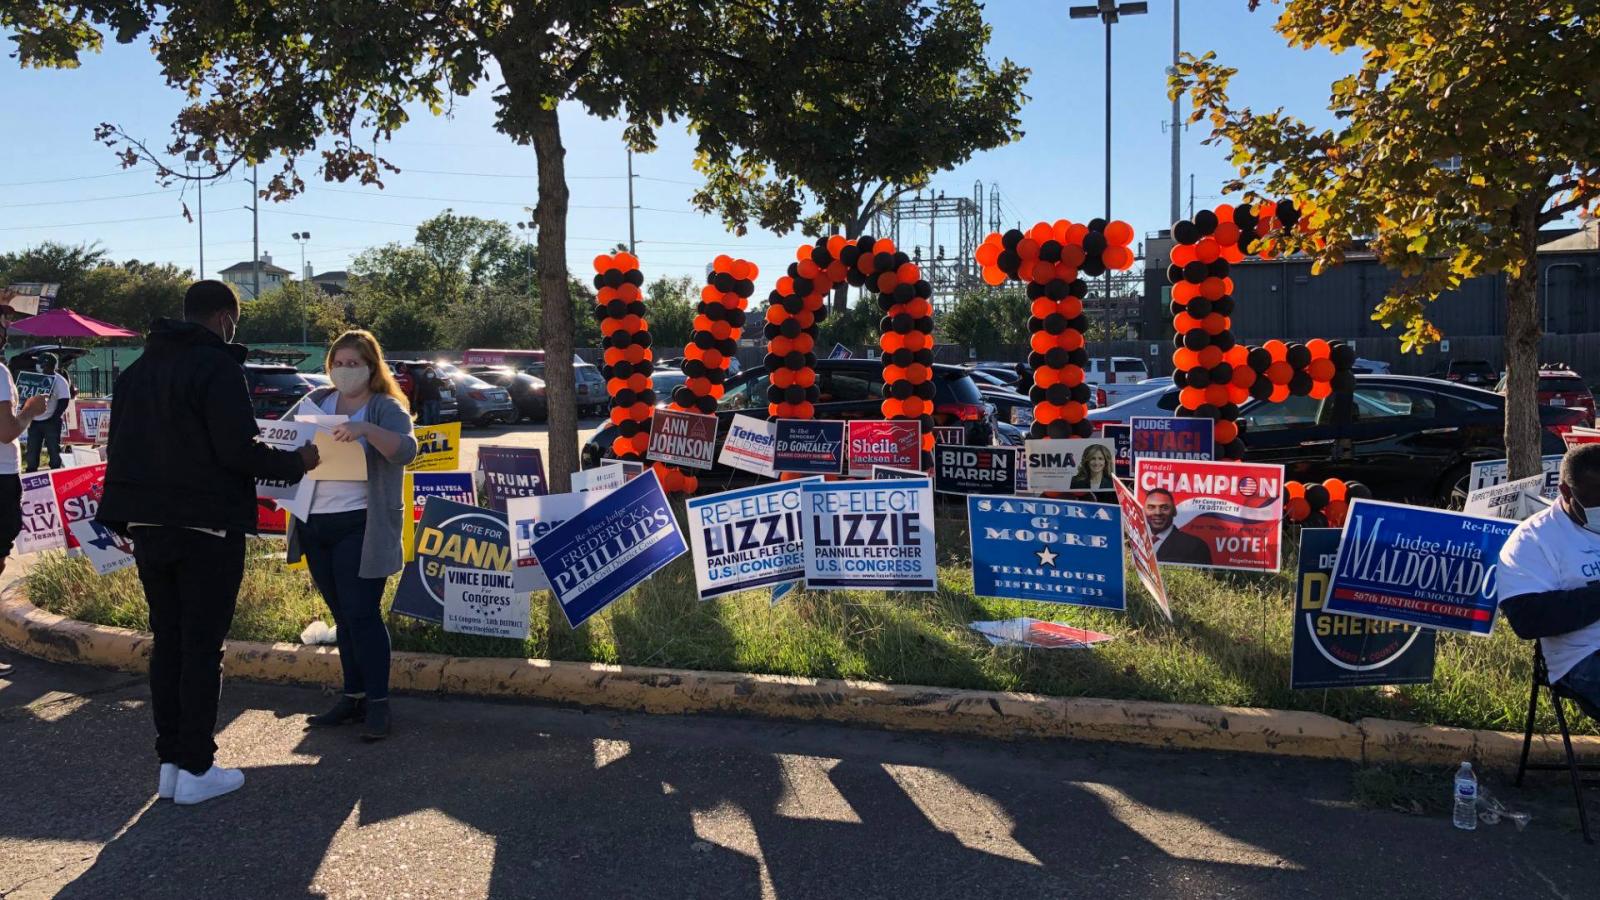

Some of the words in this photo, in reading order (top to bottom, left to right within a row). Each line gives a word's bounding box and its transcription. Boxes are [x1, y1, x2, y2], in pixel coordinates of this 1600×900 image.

[662, 416, 688, 436] ANN
[1134, 420, 1170, 430] JUDGE
[268, 428, 298, 441] 2020
[1134, 431, 1200, 450] STACI
[650, 433, 713, 460] JOHNSON
[776, 440, 788, 451] ED
[790, 440, 832, 452] GONZALEZ
[852, 438, 898, 454] Sheila
[854, 454, 890, 463] Jackson
[894, 455, 911, 463] Lee
[942, 451, 1008, 468] BIDEN
[1029, 453, 1076, 468] SIMA
[488, 472, 540, 488] TRUMP
[942, 466, 1008, 482] HARRIS
[497, 487, 535, 497] PENCE
[700, 490, 800, 526] RE-ELEC
[812, 490, 918, 512] RE-ELECT
[977, 500, 1112, 521] SANDRA
[461, 522, 482, 535] VOTE
[484, 528, 502, 539] FOR
[576, 520, 606, 543] Re-Elect
[606, 508, 626, 526] Judge
[813, 513, 920, 546] LIZZIE
[1031, 516, 1058, 530] G.
[1462, 520, 1513, 536] Re-Elect
[34, 530, 56, 541] Texas
[560, 504, 650, 568] FREDERICKA
[984, 527, 1108, 548] MOORE
[1216, 536, 1268, 552] VOTE!
[553, 508, 669, 595] PHILLIPS
[815, 548, 860, 558] PANNILL
[864, 547, 922, 558] FLETCHER
[1392, 532, 1440, 556] Judge
[1442, 540, 1482, 560] Julia
[594, 564, 612, 582] Civil
[612, 550, 638, 572] District
[639, 535, 660, 553] Court
[708, 550, 756, 568] PANNILL
[760, 542, 804, 560] FLETCH
[1340, 515, 1497, 600] MALDONADO
[708, 566, 736, 580] U.S.
[816, 560, 841, 572] U.S.
[844, 560, 922, 572] CONGRESS
[990, 565, 1044, 576] TEXAS
[1050, 568, 1106, 582] HOUSE
[448, 570, 478, 586] VINCE
[994, 579, 1076, 594] DISTRICT
[1081, 586, 1104, 597] 133
[462, 590, 510, 606] Congress
[1414, 590, 1465, 604] DEMOCRAT
[1380, 595, 1430, 610] DISTRICT
[1431, 602, 1472, 617] COURT
